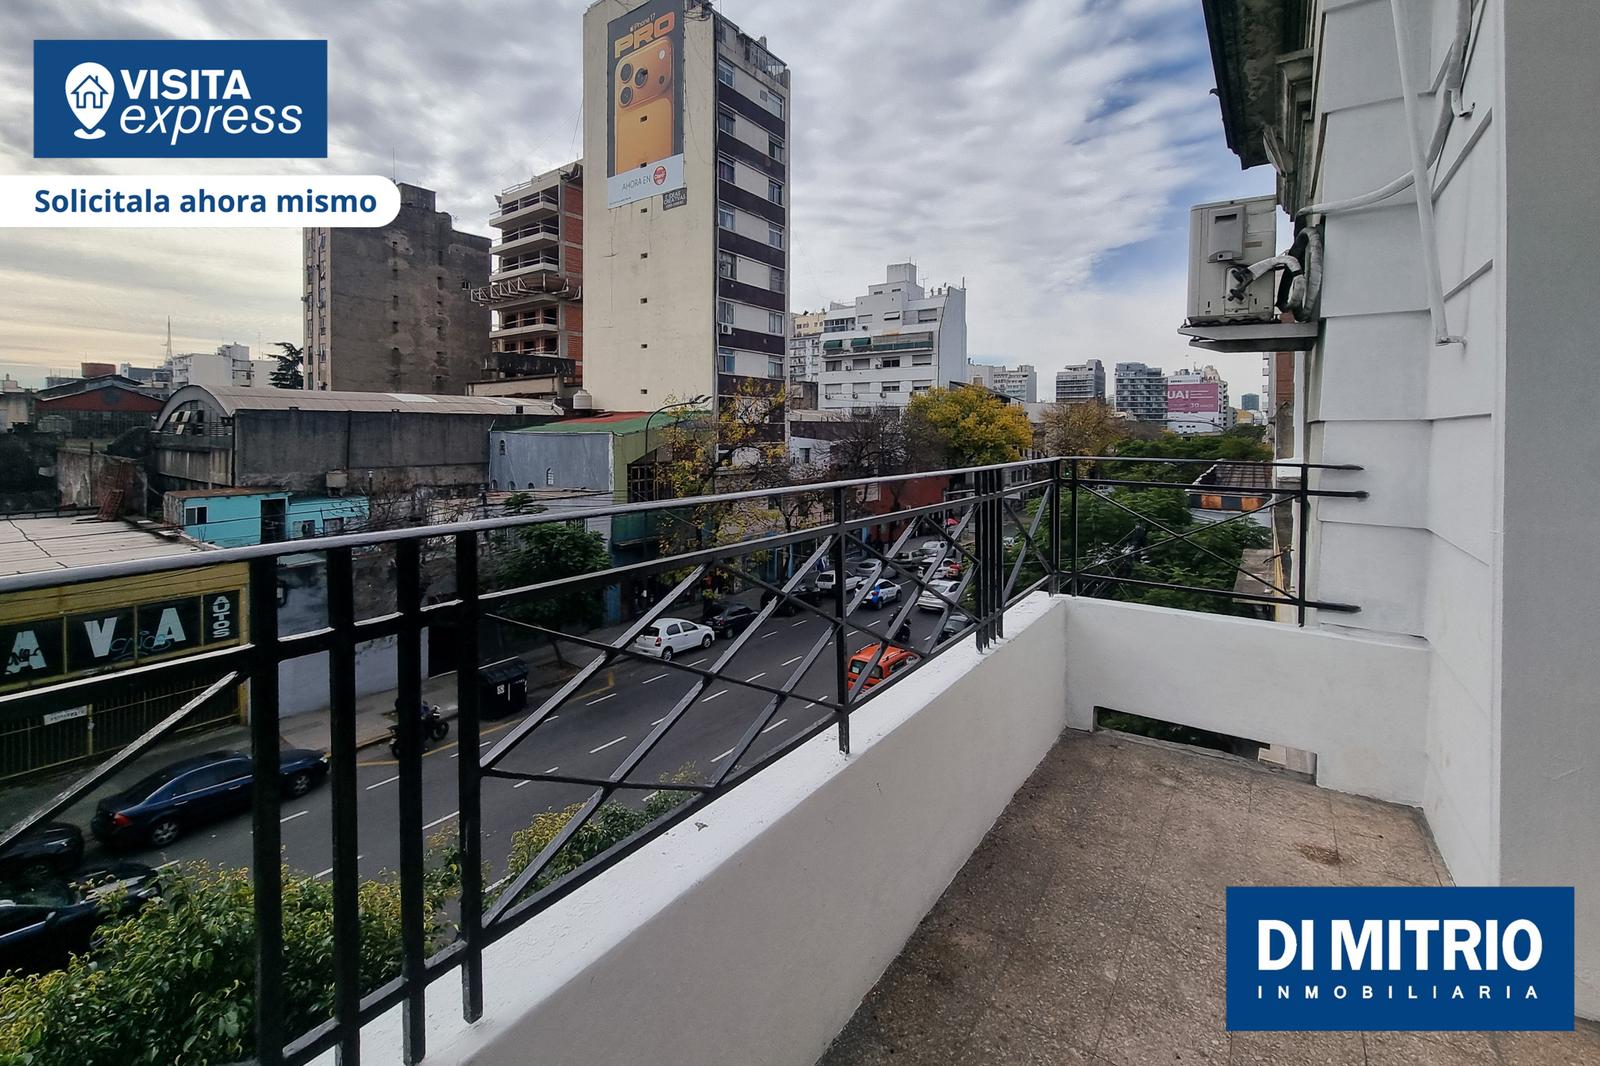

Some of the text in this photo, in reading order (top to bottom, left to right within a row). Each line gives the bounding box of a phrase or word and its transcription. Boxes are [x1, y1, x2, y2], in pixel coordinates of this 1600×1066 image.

[614, 11, 675, 59] PRO
[622, 178, 642, 192] AHORA
[643, 175, 651, 185] EN
[212, 595, 230, 638] AUTOS
